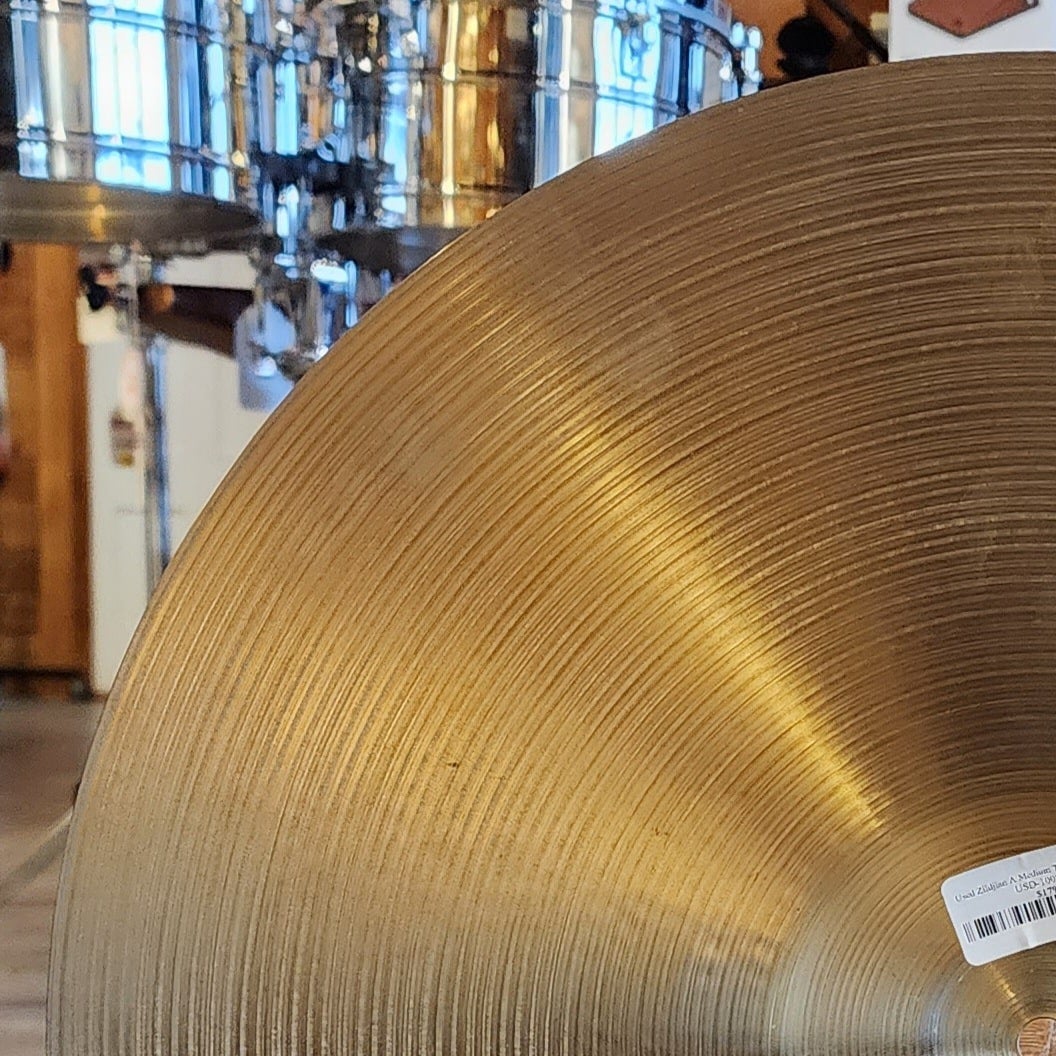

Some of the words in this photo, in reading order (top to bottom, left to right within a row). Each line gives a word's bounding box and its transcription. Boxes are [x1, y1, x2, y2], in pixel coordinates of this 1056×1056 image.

[954, 890, 976, 902] Used
[977, 881, 1008, 896] Zildjian
[1009, 876, 1018, 885] A
[1018, 867, 1052, 881] Medium
